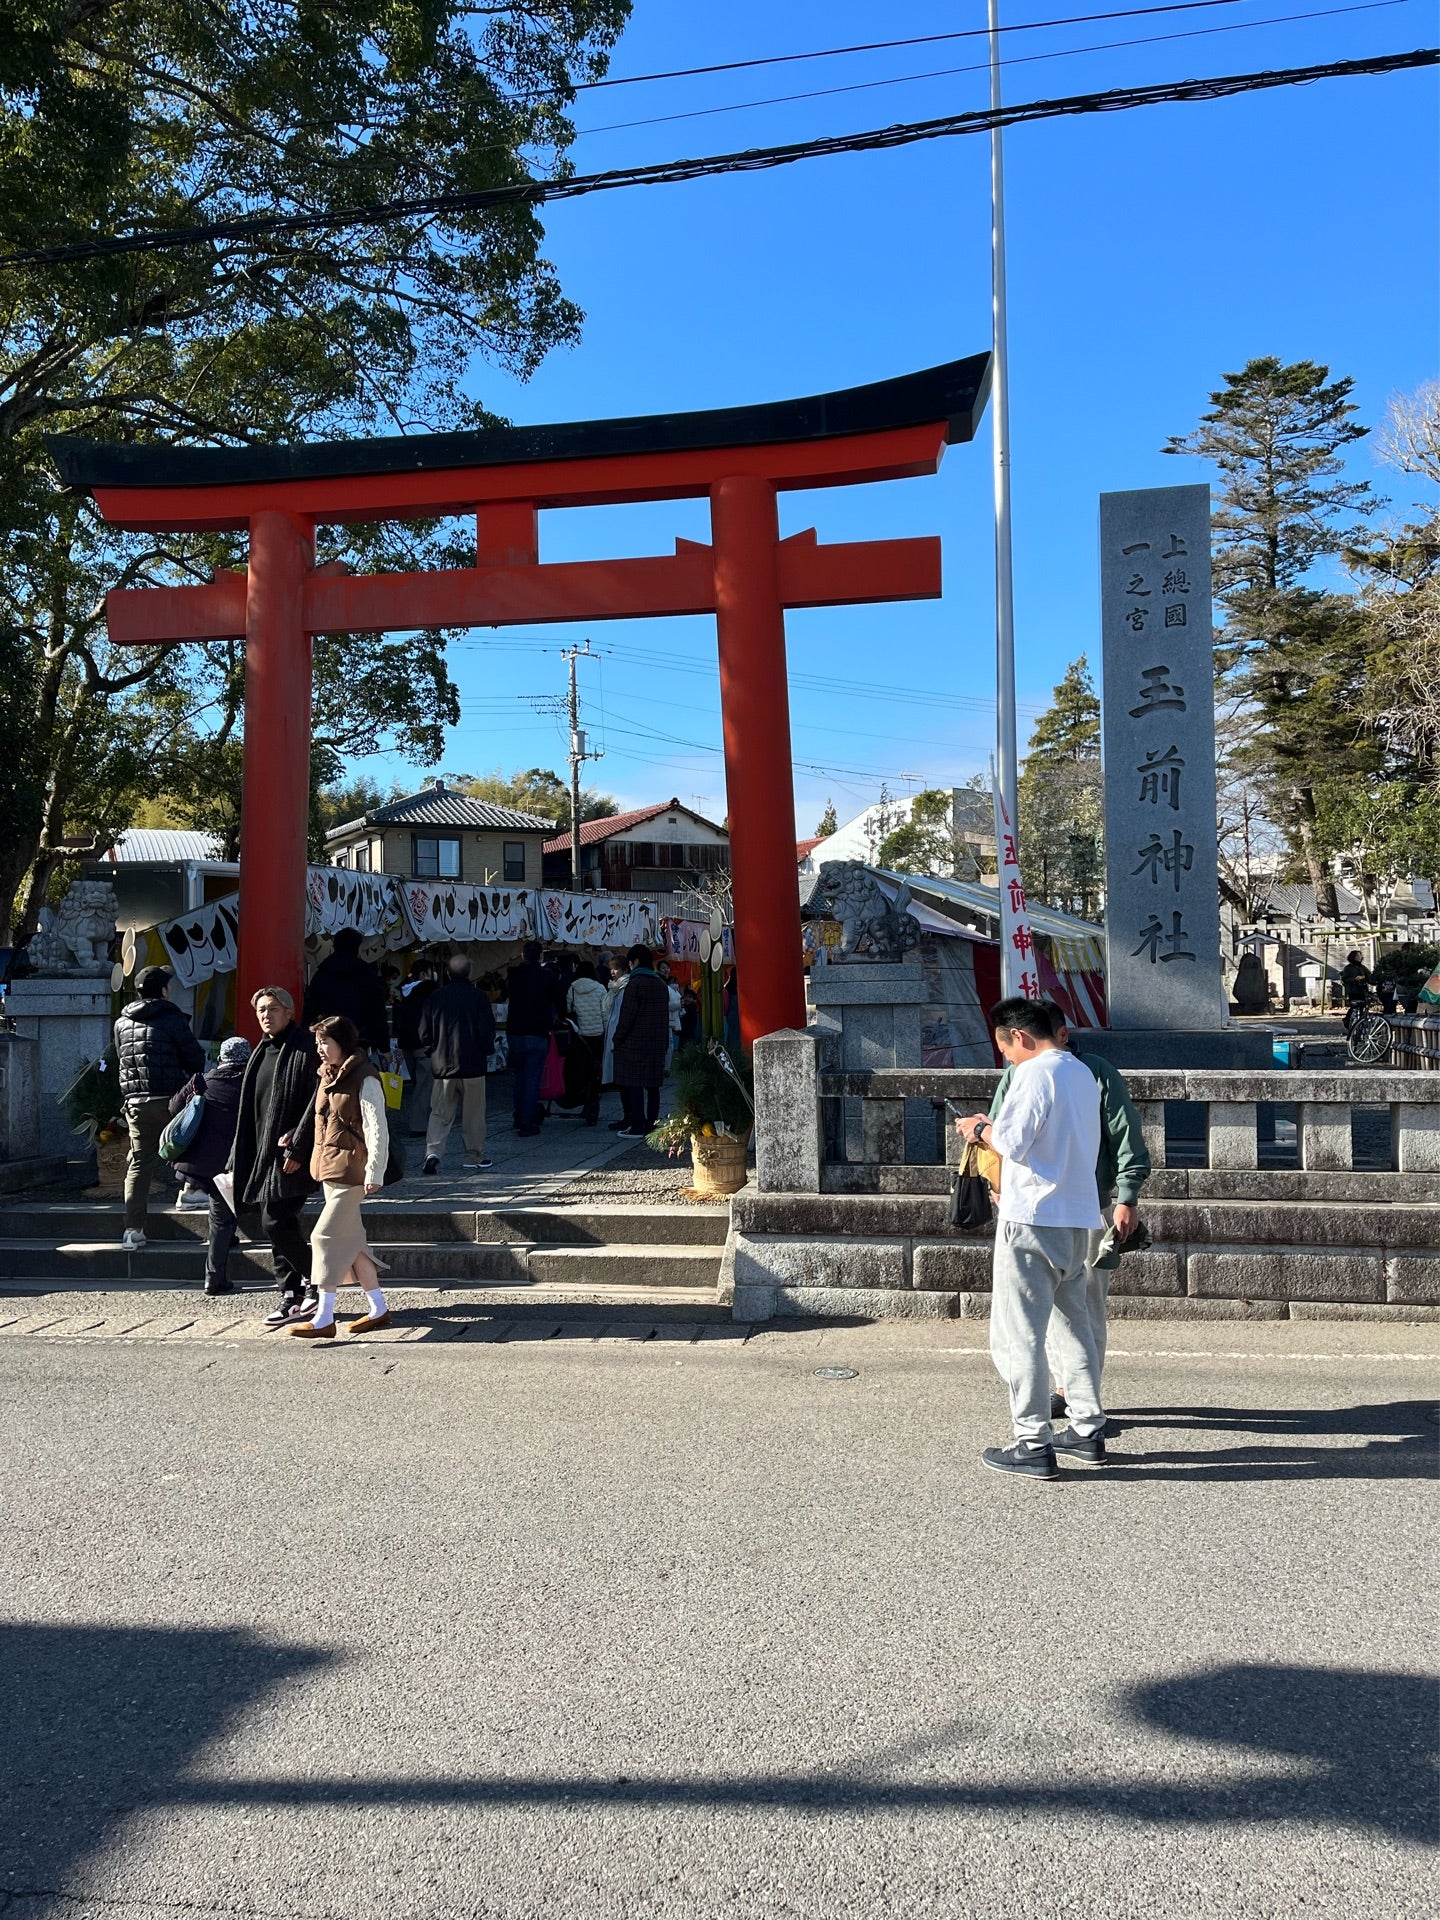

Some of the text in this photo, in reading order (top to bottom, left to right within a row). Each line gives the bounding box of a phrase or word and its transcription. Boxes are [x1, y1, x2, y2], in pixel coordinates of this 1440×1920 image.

[1121, 542, 1152, 632] 一之宮
[1161, 533, 1190, 627] 上總國
[1128, 665, 1197, 965] 玉前神社
